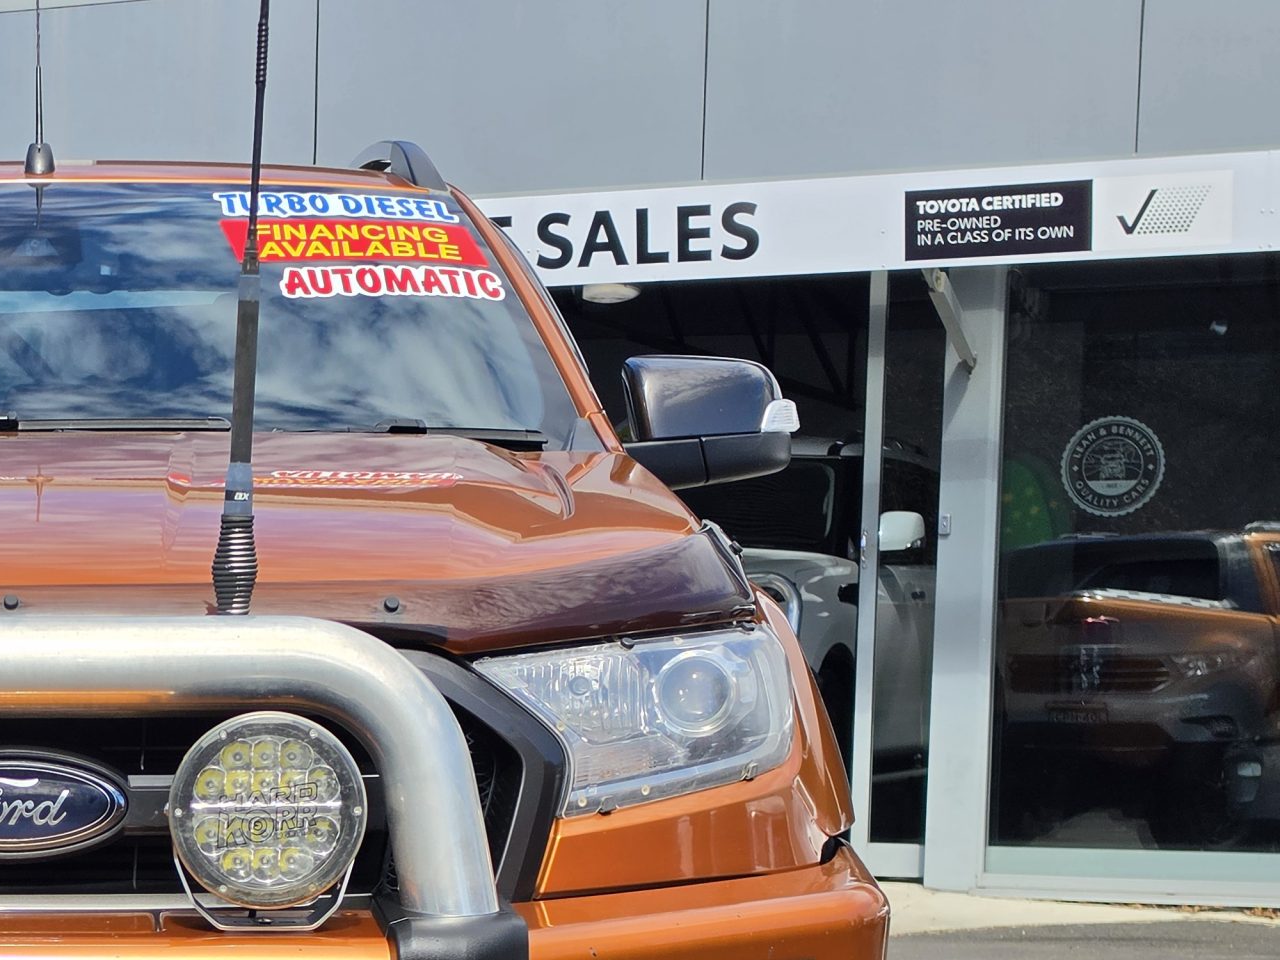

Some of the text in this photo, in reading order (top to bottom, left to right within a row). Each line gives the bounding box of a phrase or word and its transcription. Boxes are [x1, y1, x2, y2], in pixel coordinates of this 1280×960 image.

[218, 193, 456, 221] TURBO DIESEL
[916, 192, 1064, 214] TOYOTA CERTIFIED
[257, 223, 449, 243] FINANCING
[536, 201, 760, 270] SALES
[916, 215, 1001, 232] PRE-OWNED
[917, 225, 1075, 246] IN A CLASS OF ITS OWN
[259, 240, 463, 261] AVAILABLE
[285, 267, 502, 300] AUTOMATIC
[1111, 425, 1154, 457] BENNETT
[1076, 479, 1150, 507] QUALITY CARS
